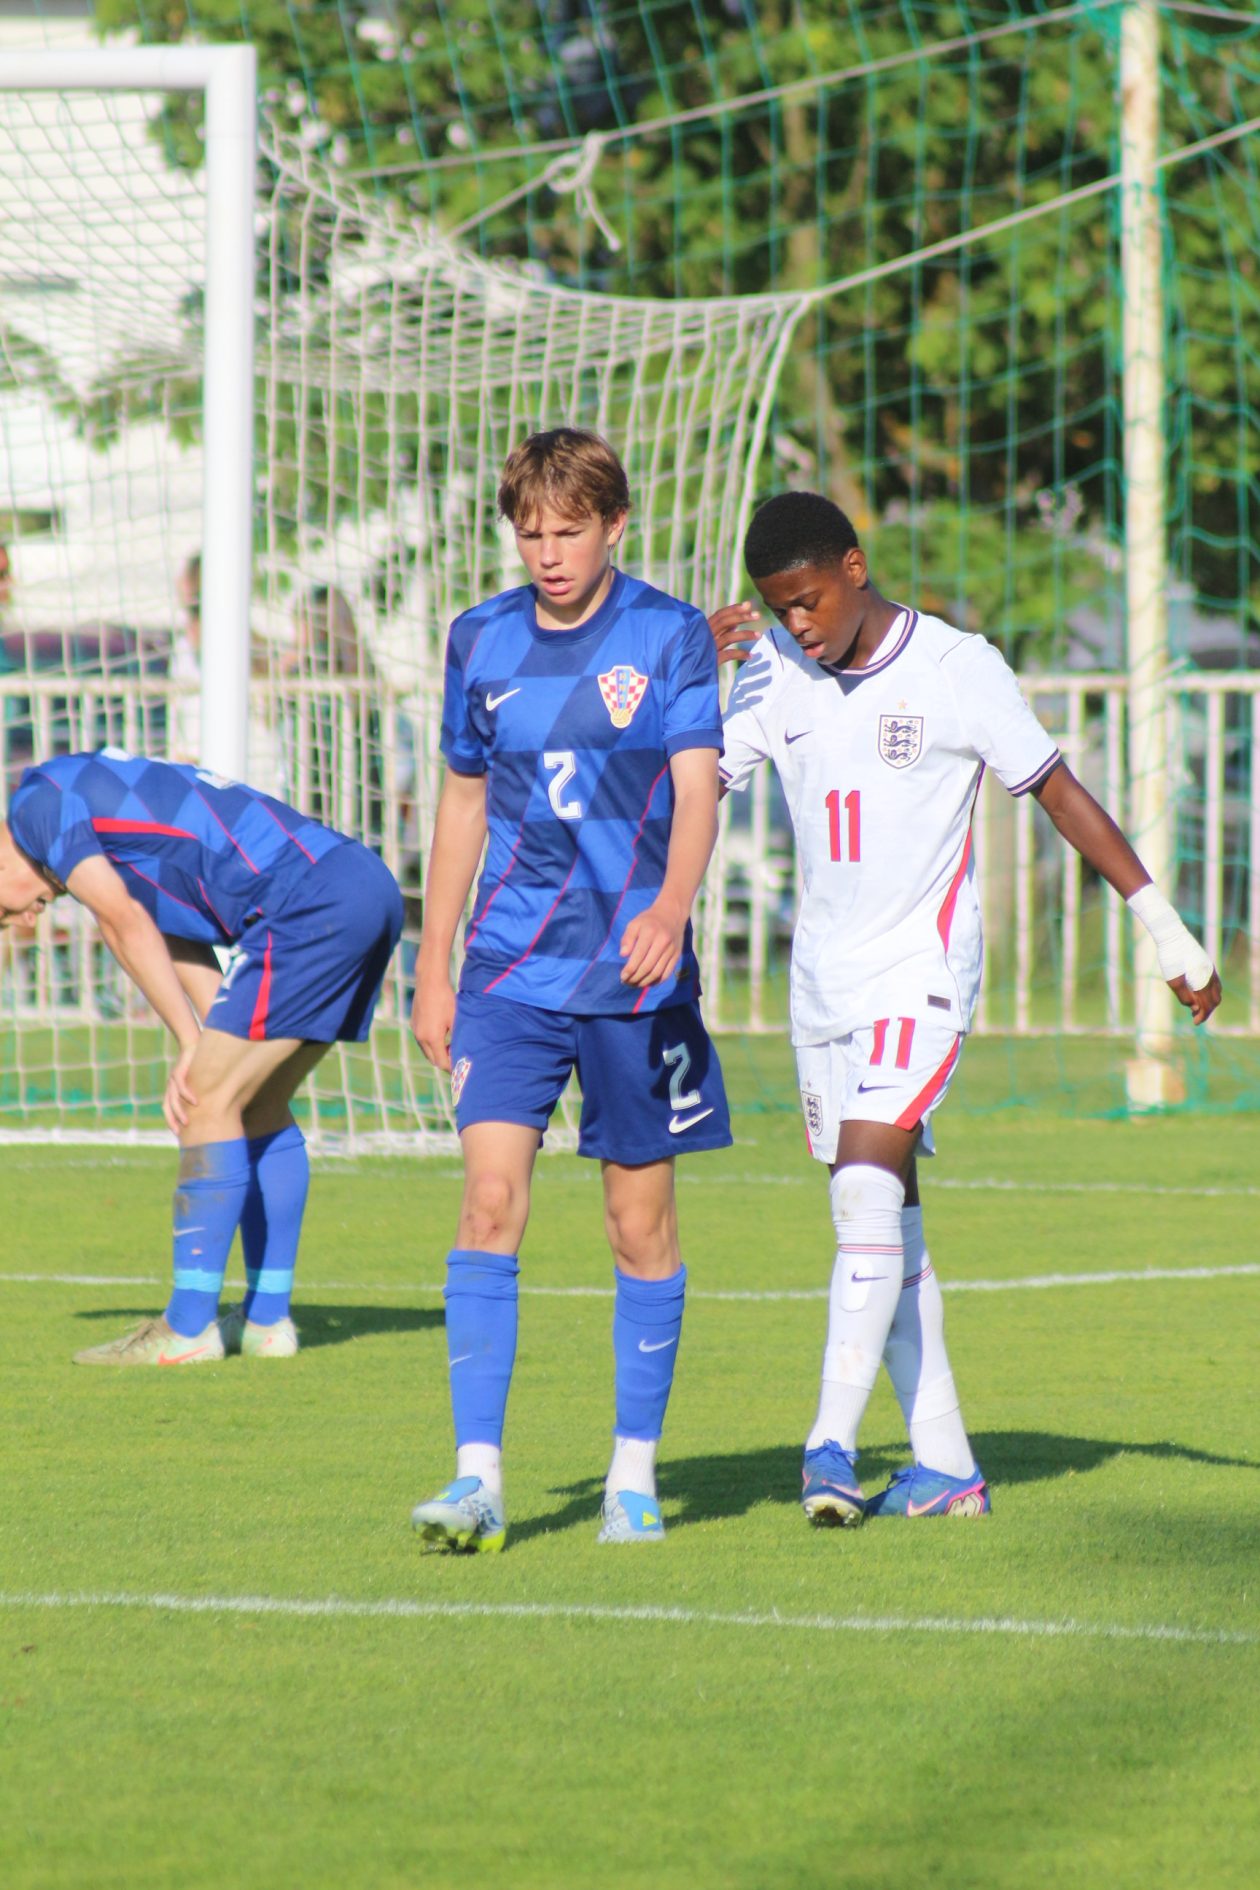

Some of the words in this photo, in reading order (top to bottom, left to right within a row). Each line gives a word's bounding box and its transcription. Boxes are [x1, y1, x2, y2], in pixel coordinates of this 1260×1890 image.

[543, 751, 582, 819] 2
[825, 789, 861, 863] 11
[662, 1042, 701, 1110] 2
[869, 1016, 916, 1070] 11
